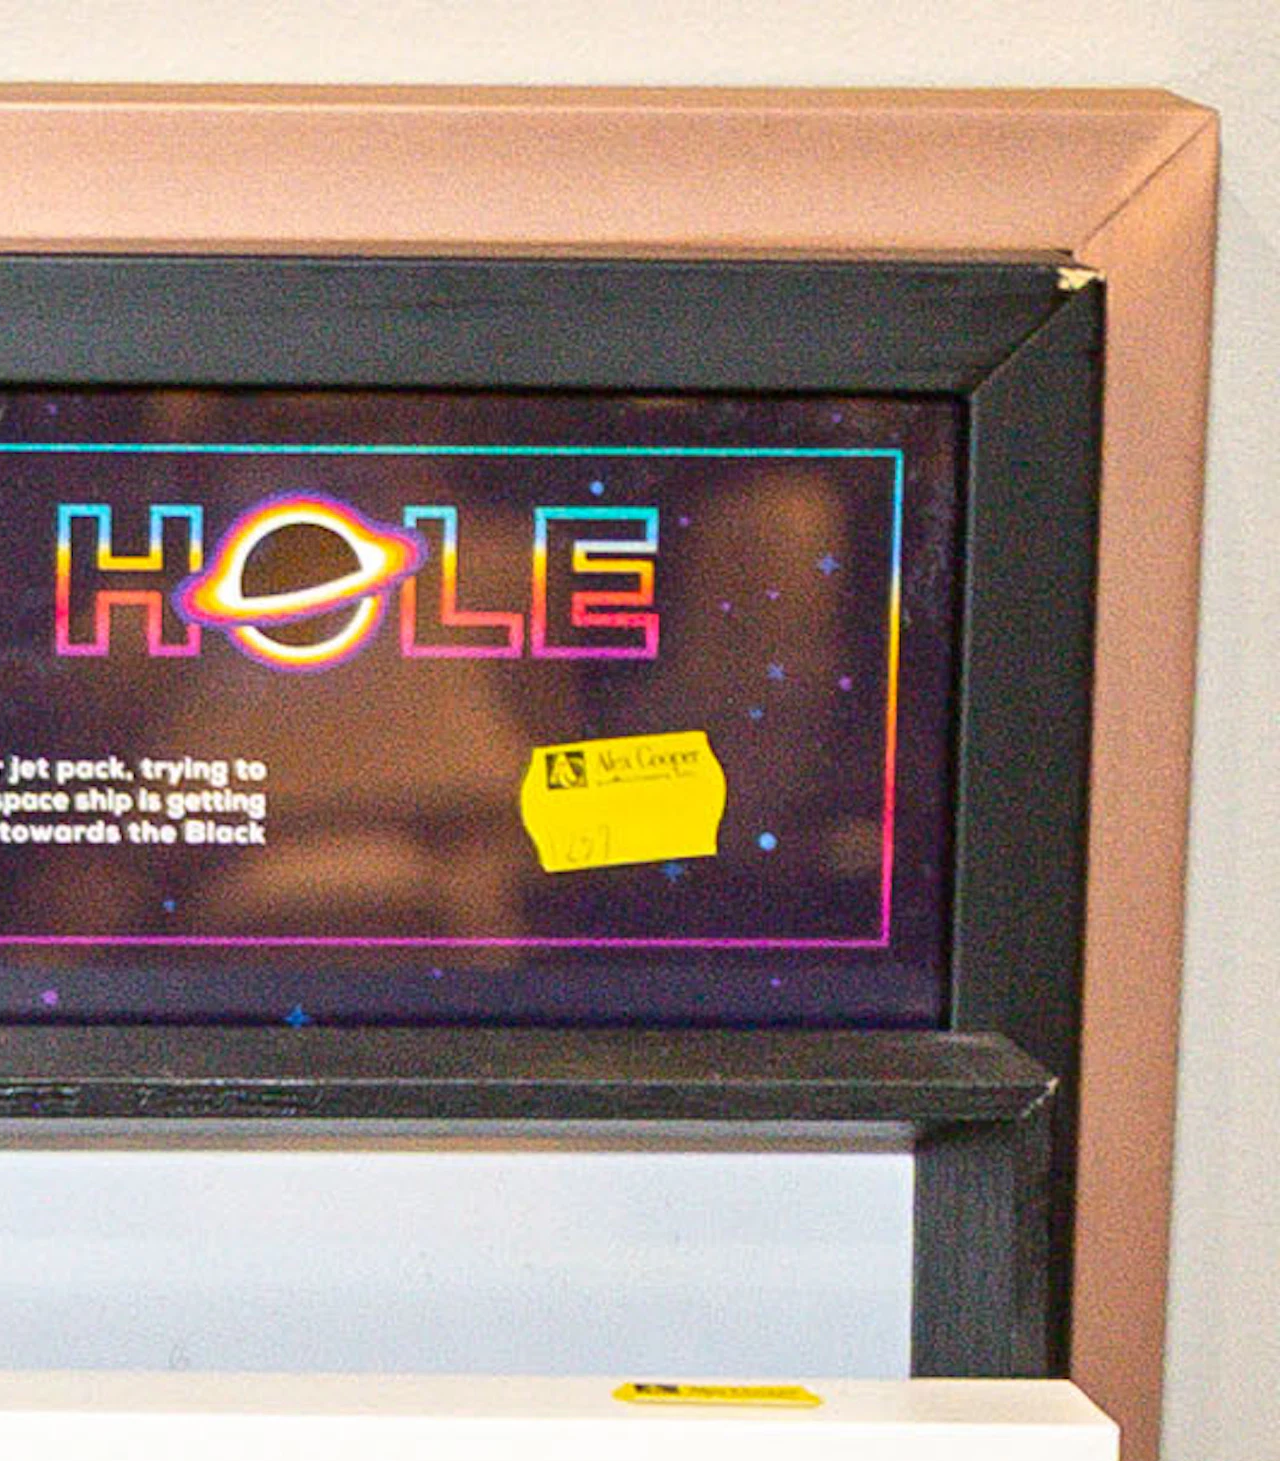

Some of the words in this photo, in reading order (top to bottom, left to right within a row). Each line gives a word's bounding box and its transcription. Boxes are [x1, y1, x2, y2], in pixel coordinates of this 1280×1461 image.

[55, 491, 660, 669] HOLE
[8, 756, 50, 783] jet
[139, 757, 229, 784] trying
[234, 757, 267, 780] to
[75, 788, 132, 815] ship
[138, 788, 161, 811] is
[166, 789, 266, 816] getting
[126, 821, 178, 844] the
[182, 822, 266, 845] Black
